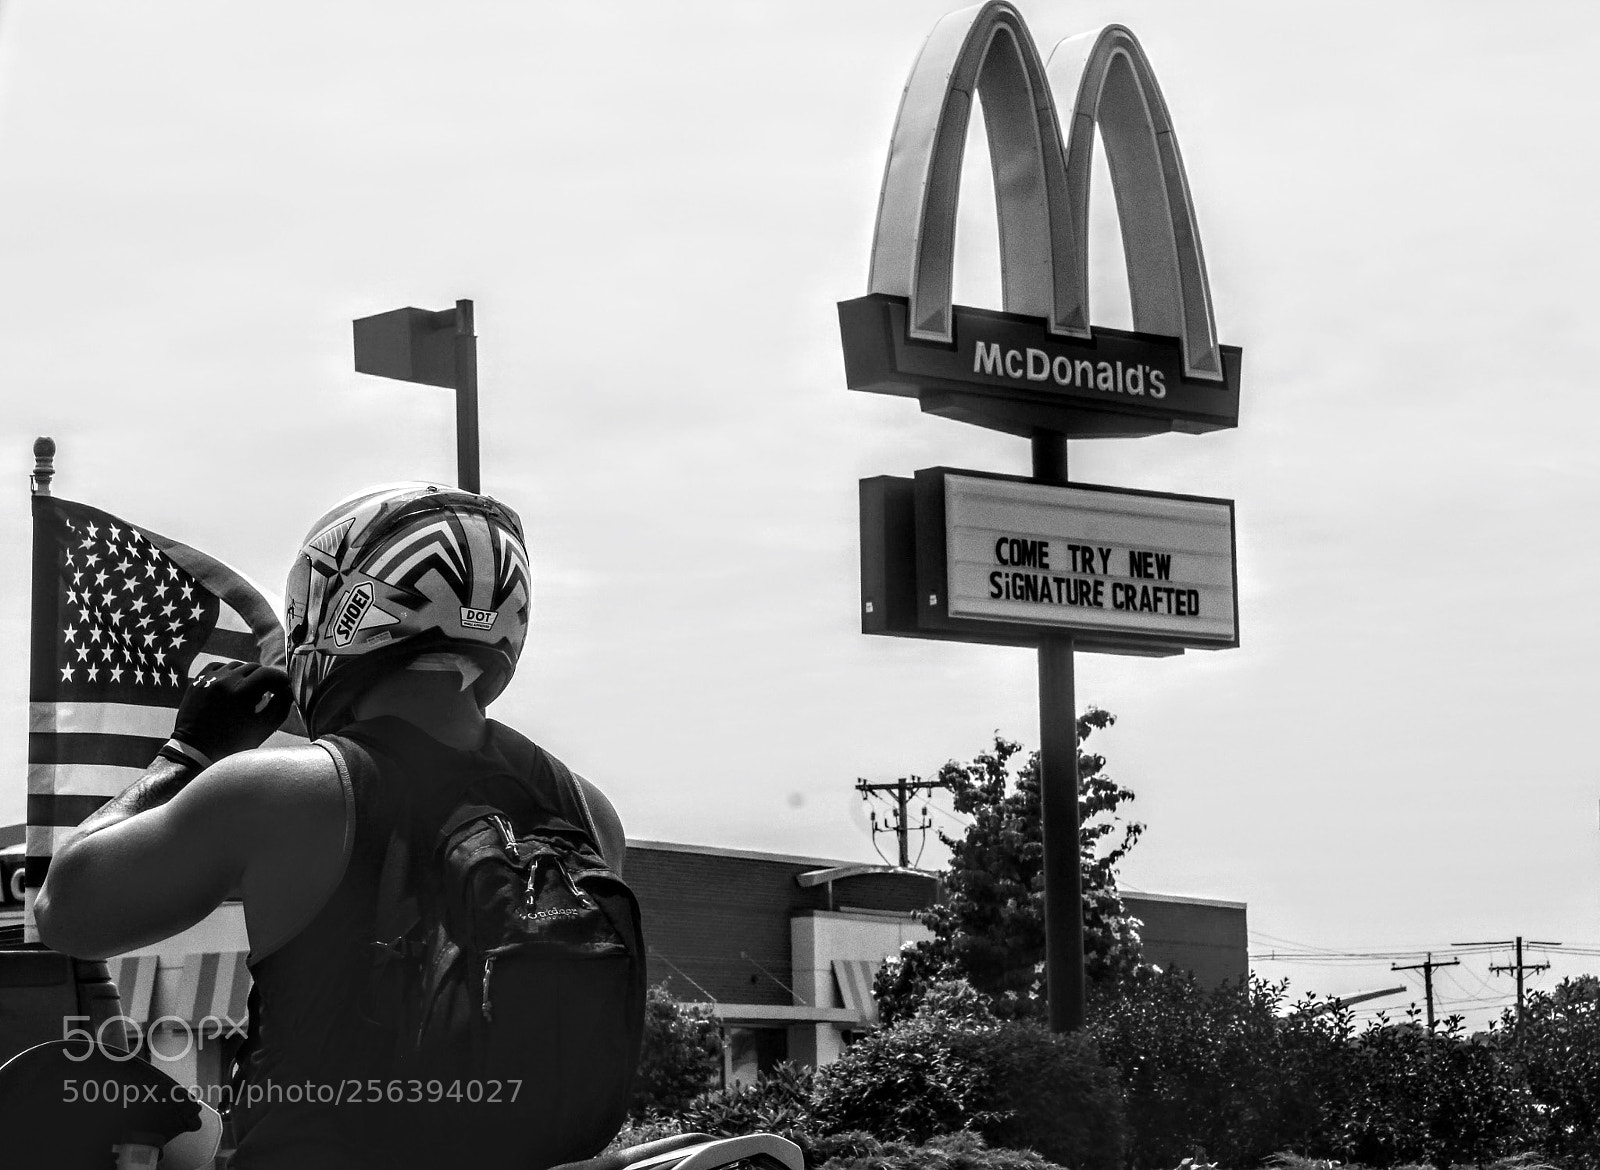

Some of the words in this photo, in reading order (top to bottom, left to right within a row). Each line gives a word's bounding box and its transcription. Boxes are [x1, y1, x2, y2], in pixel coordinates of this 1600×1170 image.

[973, 340, 1166, 399] McDonald's
[995, 537, 1050, 569] COME
[1067, 544, 1112, 575] TRY
[1129, 550, 1171, 580] NEW
[336, 589, 371, 641] SHOEI
[467, 610, 491, 622] DOT
[1112, 582, 1199, 616] CRAFTED
